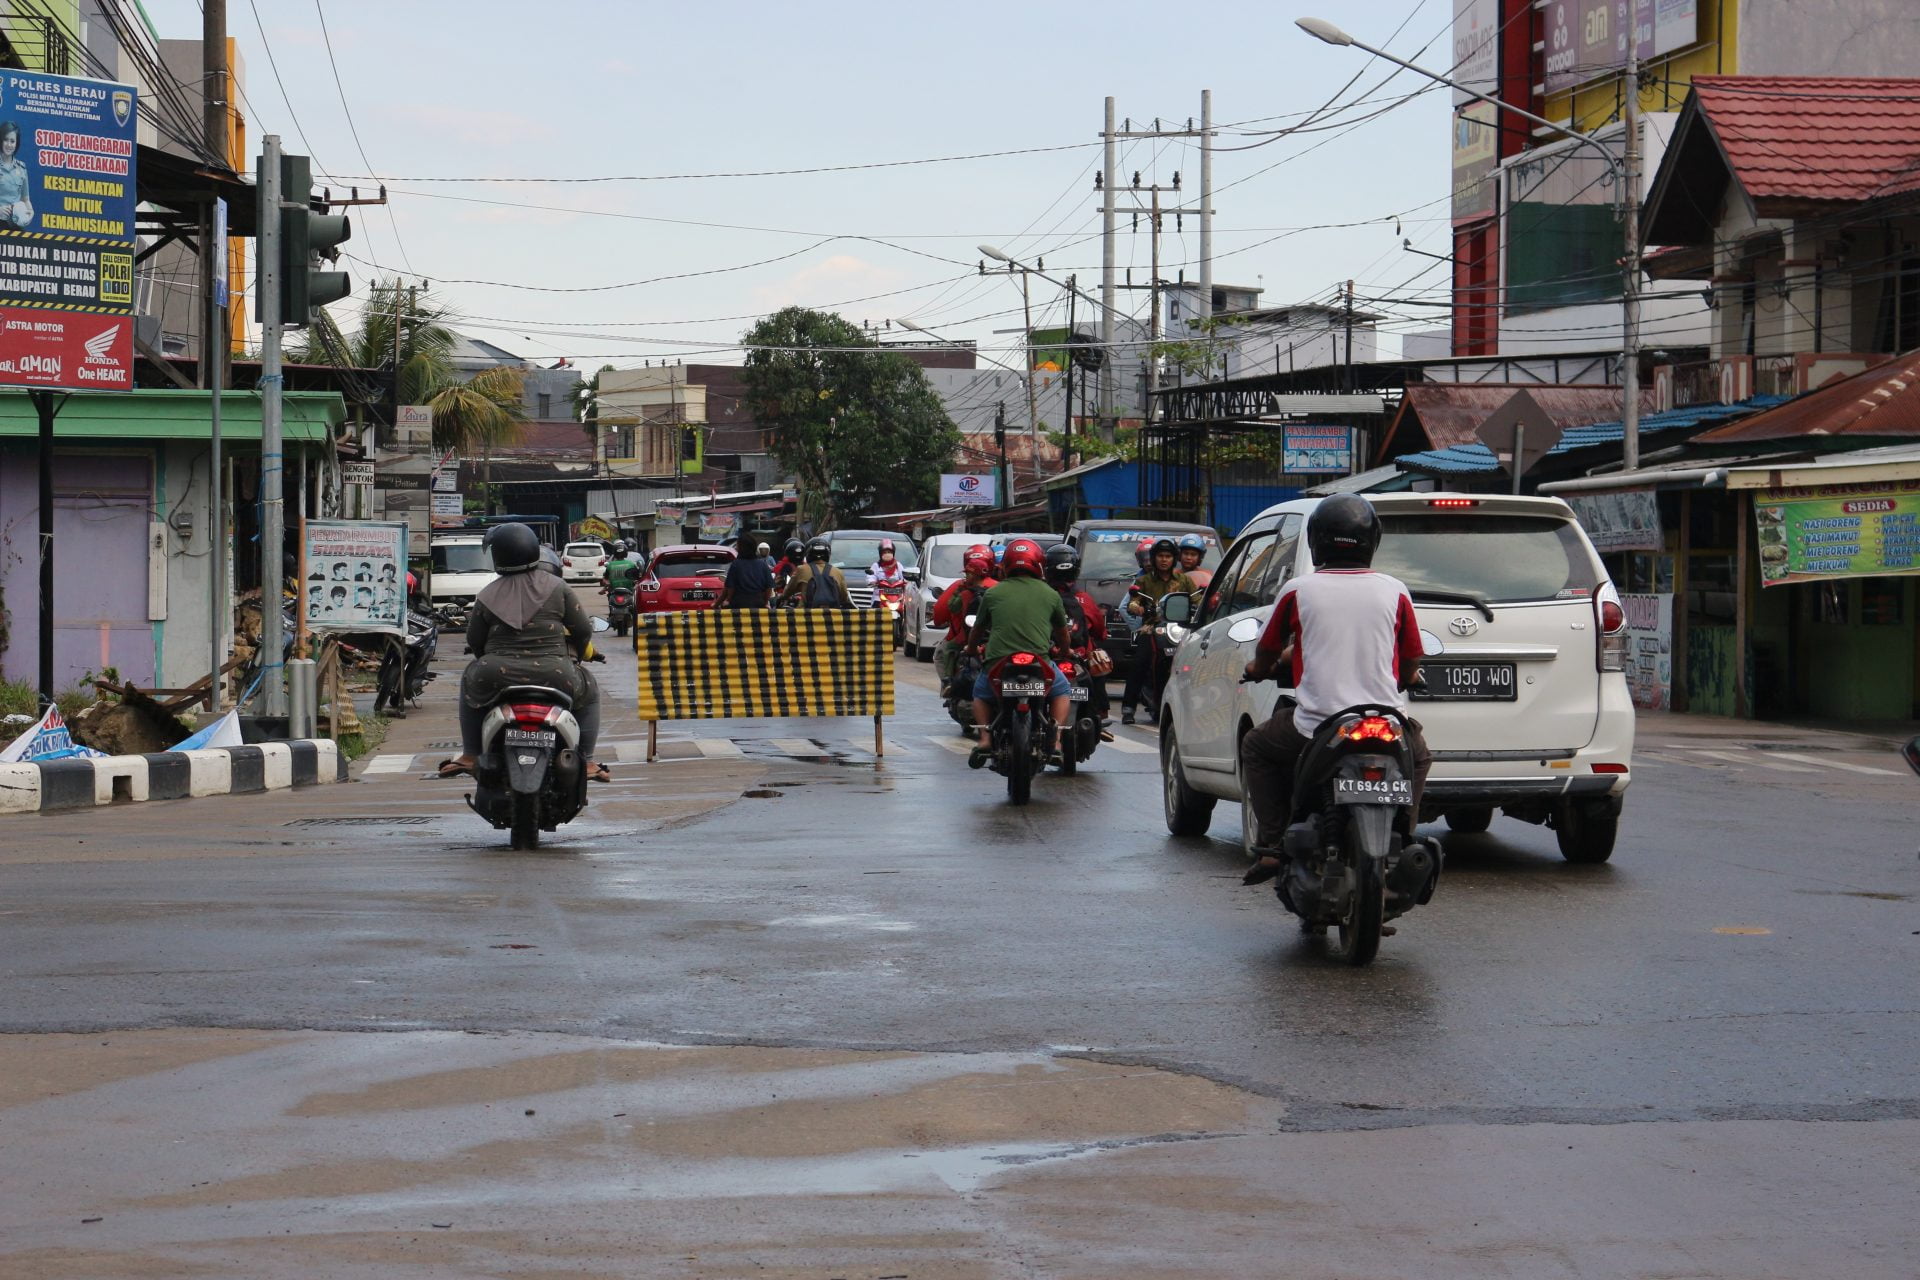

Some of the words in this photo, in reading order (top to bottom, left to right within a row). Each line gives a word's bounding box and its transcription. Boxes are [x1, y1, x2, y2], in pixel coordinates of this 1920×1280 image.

[1547, 48, 1575, 73] propan
[10, 77, 60, 94] POLRES
[64, 85, 106, 100] BERAU
[18, 91, 38, 99] POLISI
[39, 94, 58, 102] MITRA
[59, 96, 98, 107] MASYARAKAT
[27, 99, 55, 108] BERSAMA
[57, 103, 90, 112] WUJUDKAN
[15, 104, 49, 114] KEAMANAN
[64, 110, 101, 121] KETERTIBAN
[36, 129, 62, 147] STOP
[63, 132, 132, 157] PELANGGARAN
[39, 150, 65, 166] STOP
[67, 153, 128, 175] KECELAKAAN
[44, 175, 124, 197] KESELAMATAN
[63, 197, 103, 214] UNTUK
[42, 214, 124, 235] KEMANUSIAAN
[53, 248, 97, 265] BUDAYA
[102, 254, 112, 262] CALL
[113, 256, 131, 264] CENTER
[19, 263, 61, 278] BERLALU
[63, 267, 96, 281] LINTAS
[102, 264, 130, 280] POLRI
[0, 279, 58, 295] KABUPATEN
[63, 284, 96, 298] BERAU
[6, 320, 32, 330] ASTRA
[34, 322, 64, 333] MOTOR
[84, 356, 119, 366] HONDA
[77, 367, 96, 380] One
[97, 369, 126, 382] HEART.
[344, 464, 373, 474] BENGKEL
[344, 474, 373, 483] MOTOR
[1848, 500, 1890, 513] SEDIA
[1803, 519, 1825, 530] NASI
[1825, 517, 1861, 529] GORENG
[1334, 536, 1357, 544] HONDA
[1804, 534, 1826, 545] NASI
[1826, 531, 1859, 543] MAWUT
[1806, 546, 1824, 557] MIE
[1825, 544, 1860, 557] GORENG
[1807, 560, 1825, 571] MIE
[1825, 559, 1849, 570] KUAH
[1446, 668, 1481, 686] 1050
[1490, 668, 1510, 686] WO
[507, 730, 517, 738] KT
[521, 731, 539, 739] 3151
[1339, 780, 1354, 791] KT
[1357, 781, 1388, 792] 6943
[1392, 781, 1408, 792] GK
